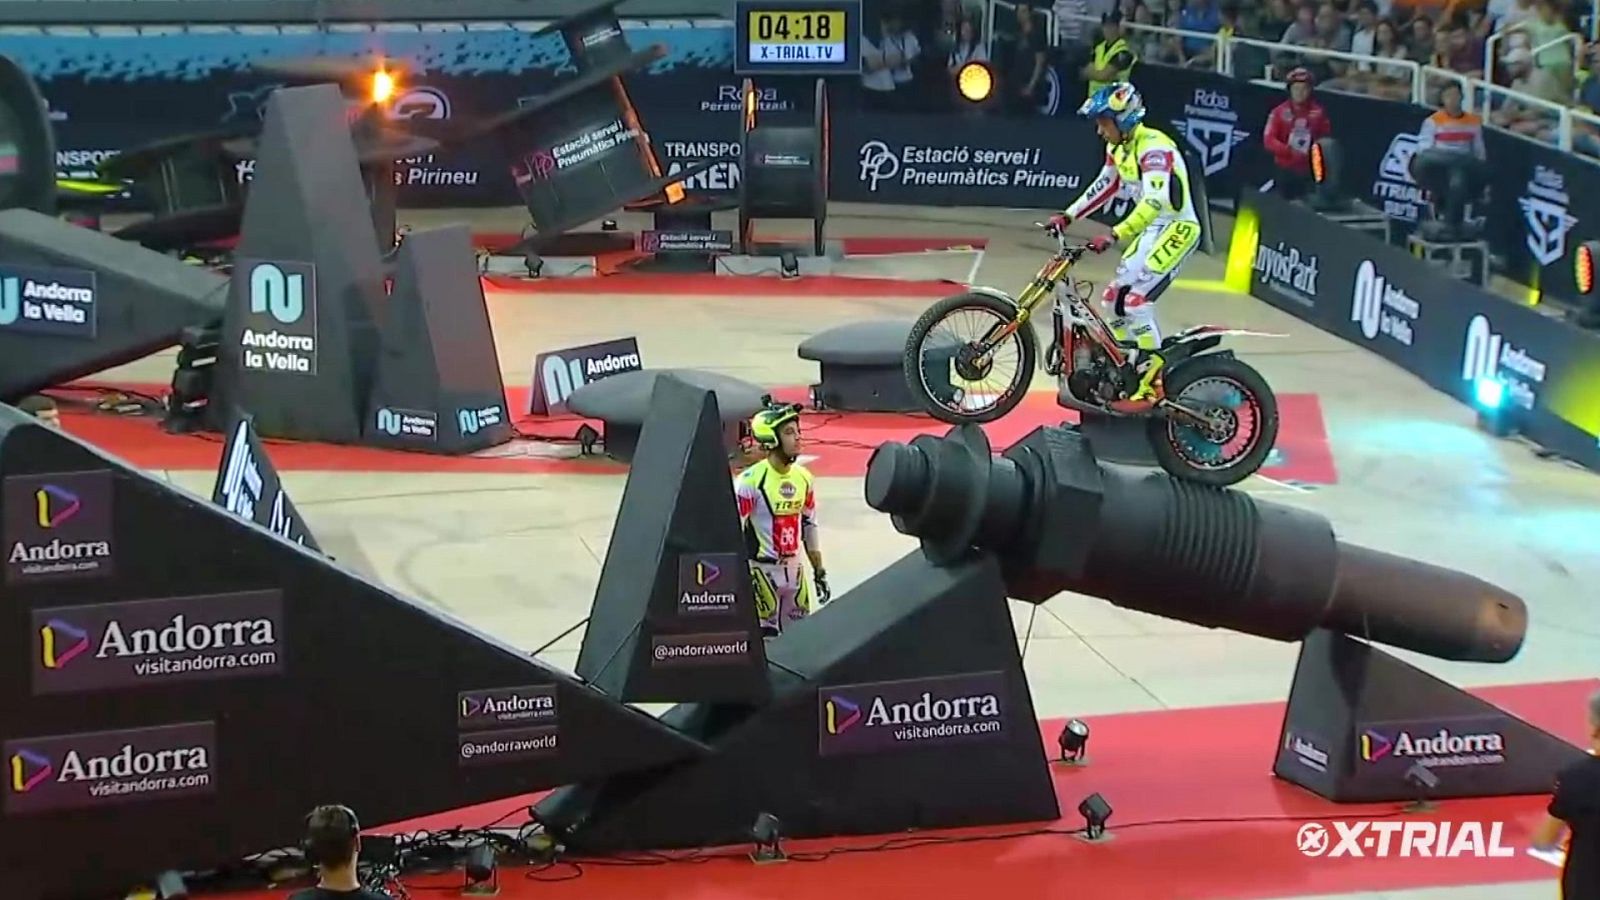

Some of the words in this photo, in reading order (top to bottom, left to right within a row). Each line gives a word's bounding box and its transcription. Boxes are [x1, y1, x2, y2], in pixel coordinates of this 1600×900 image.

[758, 14, 830, 40] 04:18
[761, 46, 833, 59] X-TRIAL.TV
[1194, 89, 1229, 109] Roba
[902, 146, 968, 164] Estació
[974, 148, 1029, 165] servei
[1033, 148, 1040, 165] i
[407, 168, 478, 185] Pirineu
[902, 167, 1009, 186] Pneumàtics
[1013, 169, 1080, 188] Pirineu
[1151, 222, 1192, 265] TRS
[1253, 242, 1319, 295] nyósPark
[24, 279, 92, 302] Andorra
[24, 301, 42, 319] la
[43, 302, 85, 323] Vella
[242, 330, 313, 351] Andorra
[245, 351, 262, 368] la
[265, 353, 309, 371] Vella
[587, 354, 639, 375] Andorra
[775, 501, 802, 510] TRS
[8, 539, 110, 563] Andorra
[681, 591, 735, 604] Andorra
[95, 614, 275, 658] Andorra
[654, 641, 748, 660] @andorraworld
[135, 652, 276, 675] visitandorra.com
[483, 695, 553, 714] Andorra
[864, 693, 999, 726] Andorra
[893, 721, 1000, 740] visitandorra.com
[461, 735, 557, 758] @andorraworld
[1393, 729, 1503, 756] Andorra
[57, 745, 208, 782] Andorra
[89, 773, 209, 797] visitandorra.com
